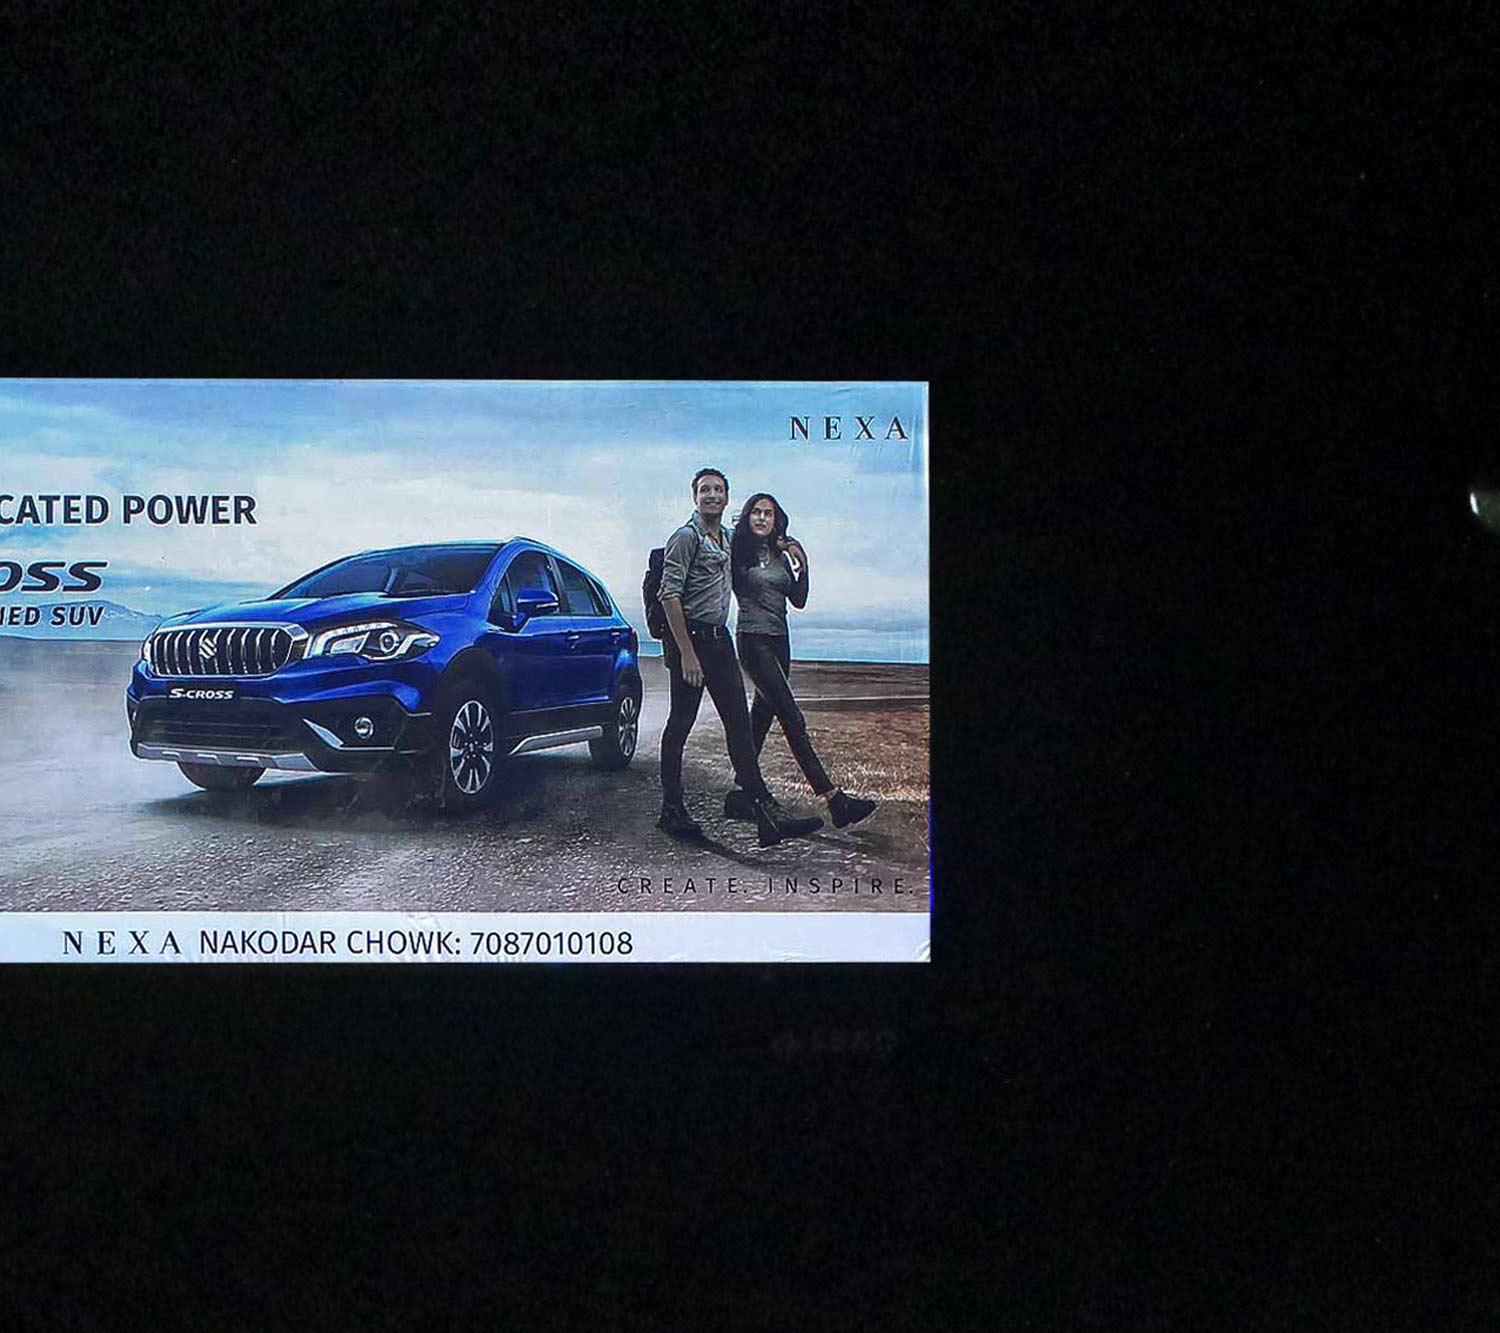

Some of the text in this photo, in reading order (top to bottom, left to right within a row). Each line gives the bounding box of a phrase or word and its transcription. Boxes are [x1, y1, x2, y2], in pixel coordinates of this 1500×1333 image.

[789, 416, 908, 440] NEXA
[123, 494, 257, 525] POWER
[51, 606, 104, 626] SUV
[169, 688, 234, 699] S-CROSS
[617, 878, 914, 894] CREATE. INSPIRE.
[62, 931, 634, 955] NEXA NAKODAR CHOWK: 7087010108
